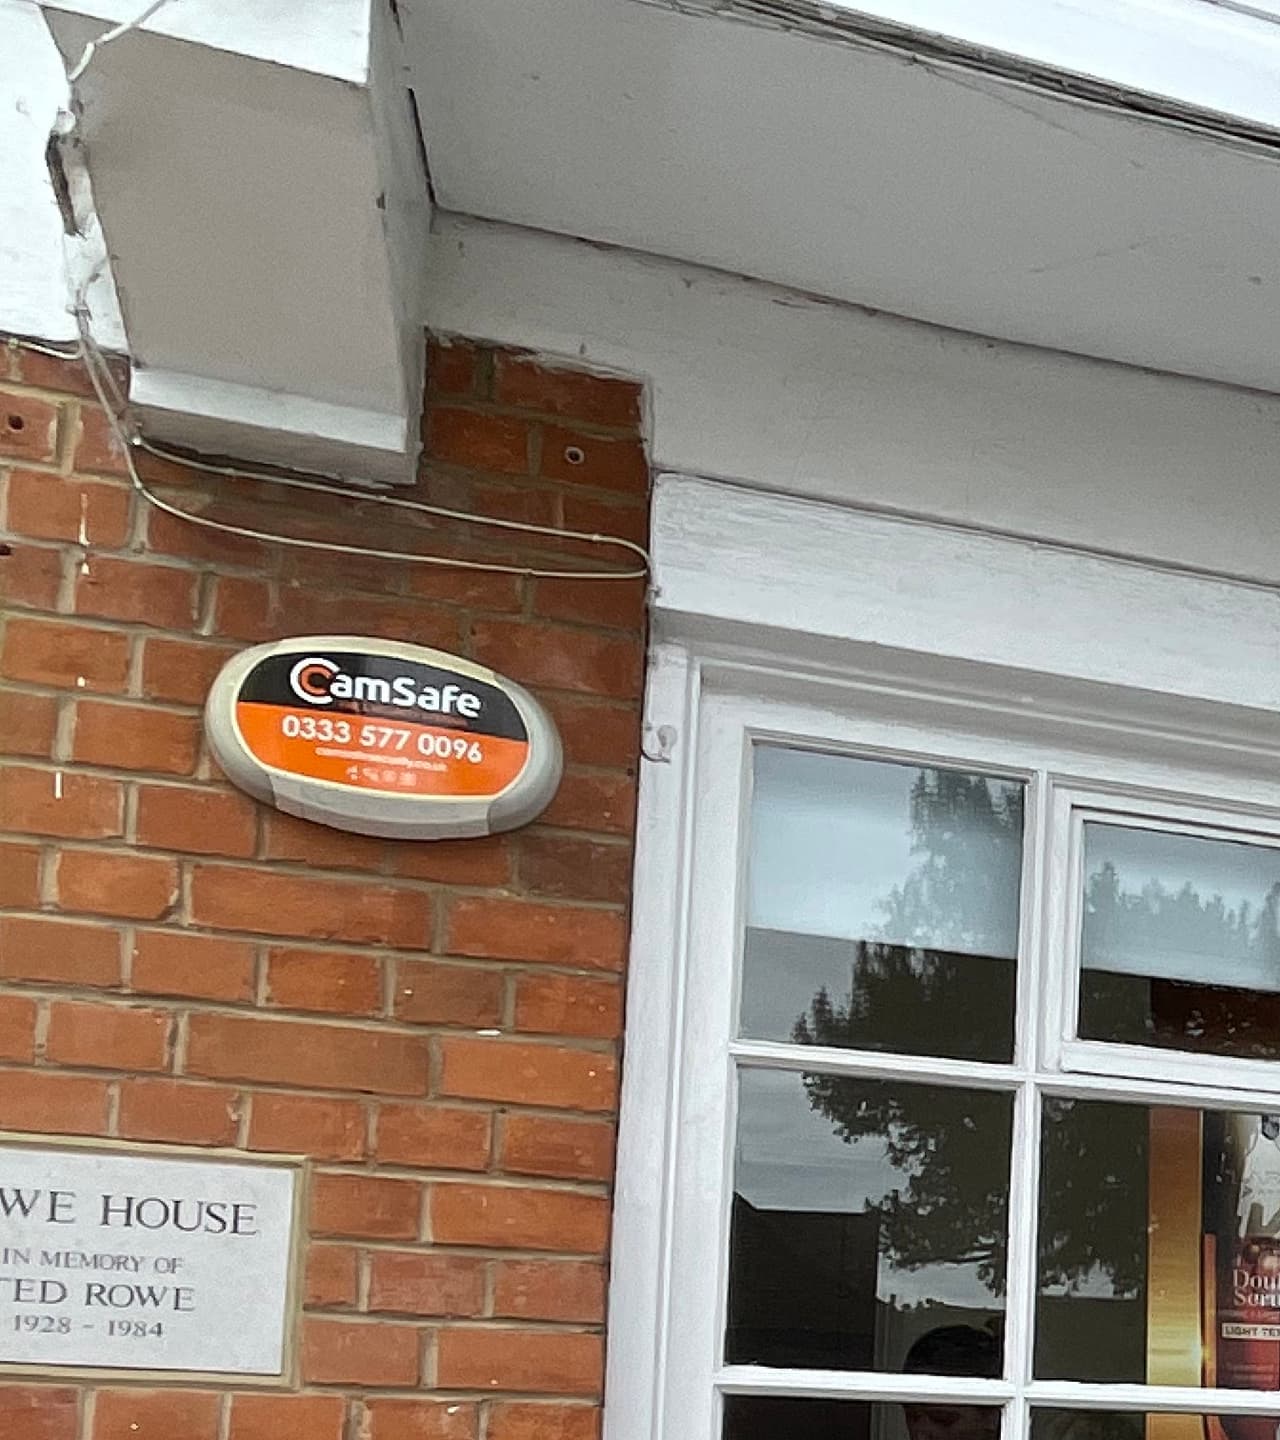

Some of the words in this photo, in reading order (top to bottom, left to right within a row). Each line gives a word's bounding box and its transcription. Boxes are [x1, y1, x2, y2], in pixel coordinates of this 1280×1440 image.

[290, 657, 482, 719] CamSafe
[281, 714, 351, 745] 0333
[360, 726, 411, 751] 577
[418, 733, 483, 764] 0096
[100, 1194, 259, 1236] HOUSE
[2, 1247, 31, 1265] IN
[40, 1250, 146, 1273] MEMORY
[153, 1256, 186, 1275] OF
[84, 1282, 196, 1312] ROWE
[13, 1314, 72, 1334] 1928
[107, 1320, 165, 1338] 1984
